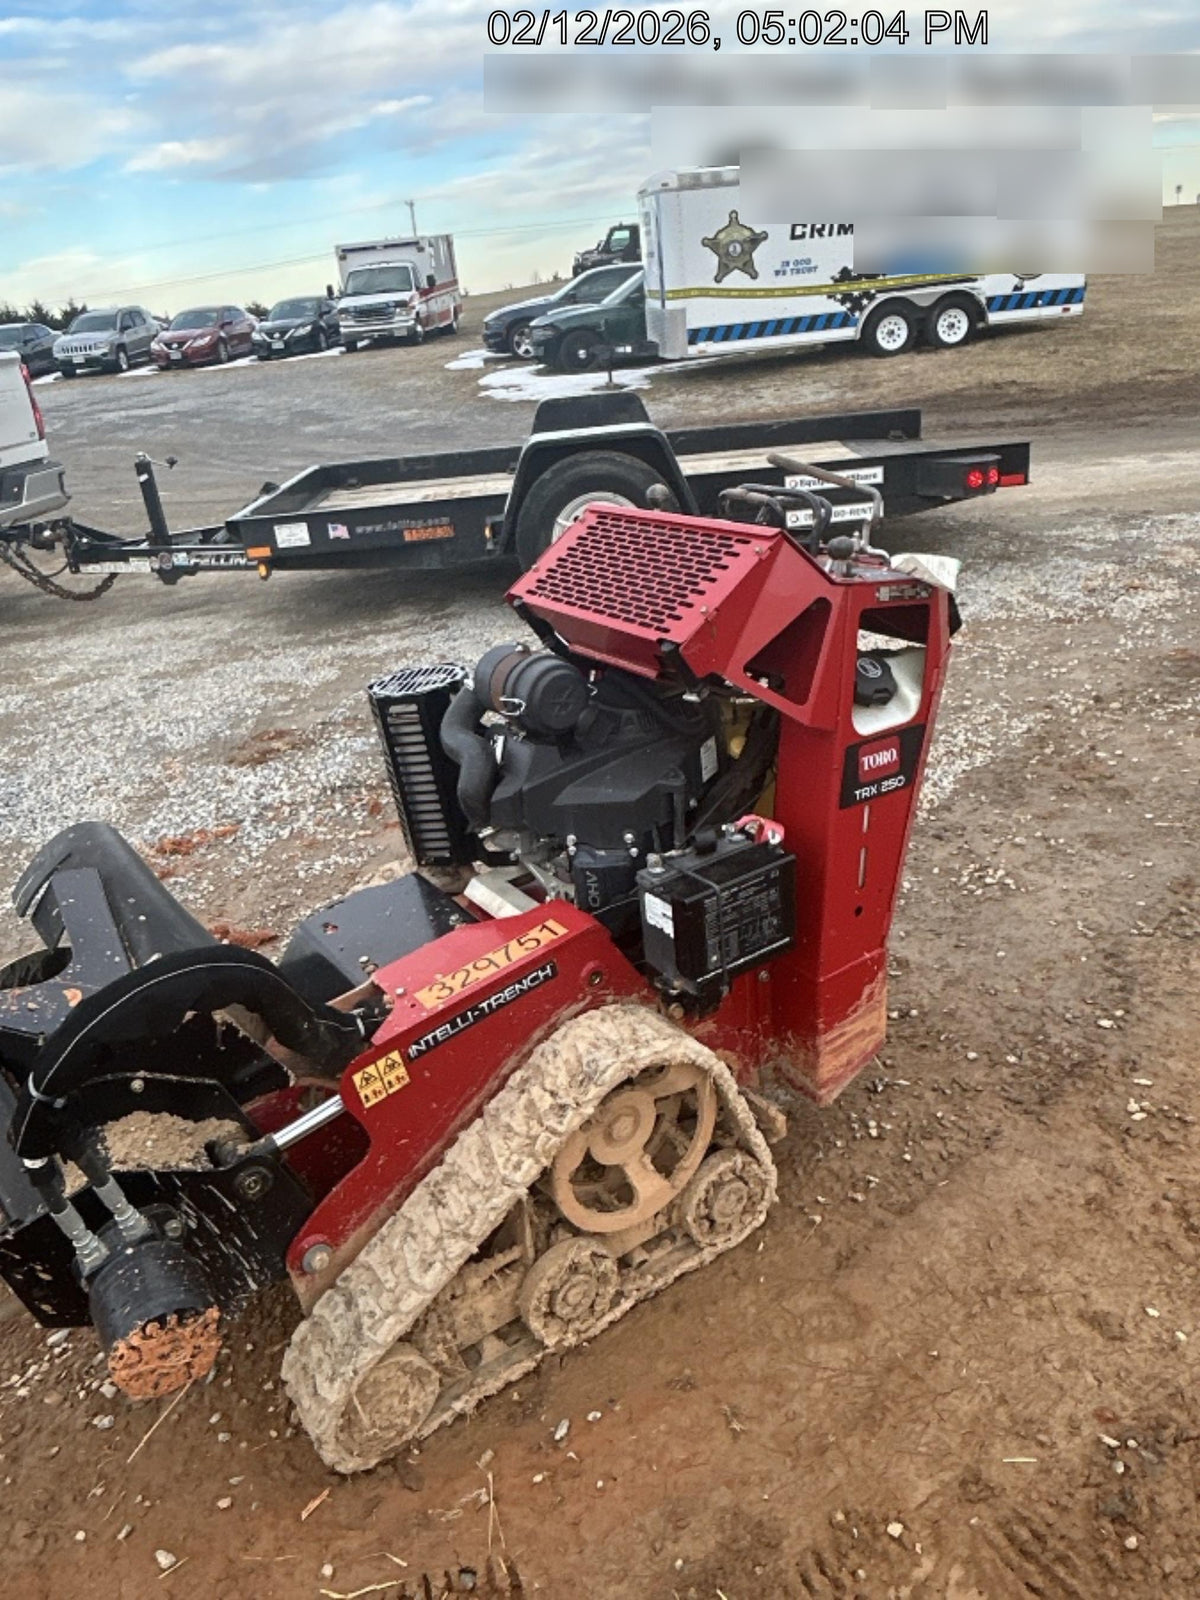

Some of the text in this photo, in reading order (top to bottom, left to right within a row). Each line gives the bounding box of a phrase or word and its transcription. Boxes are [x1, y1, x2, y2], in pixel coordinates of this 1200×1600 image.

[790, 265, 819, 275] TRUST
[862, 747, 898, 771] TORO
[854, 775, 906, 801] TRX 250
[585, 870, 601, 908] OHV
[427, 923, 560, 1001] 329751
[407, 962, 554, 1058] INTELLI-TRENCH
